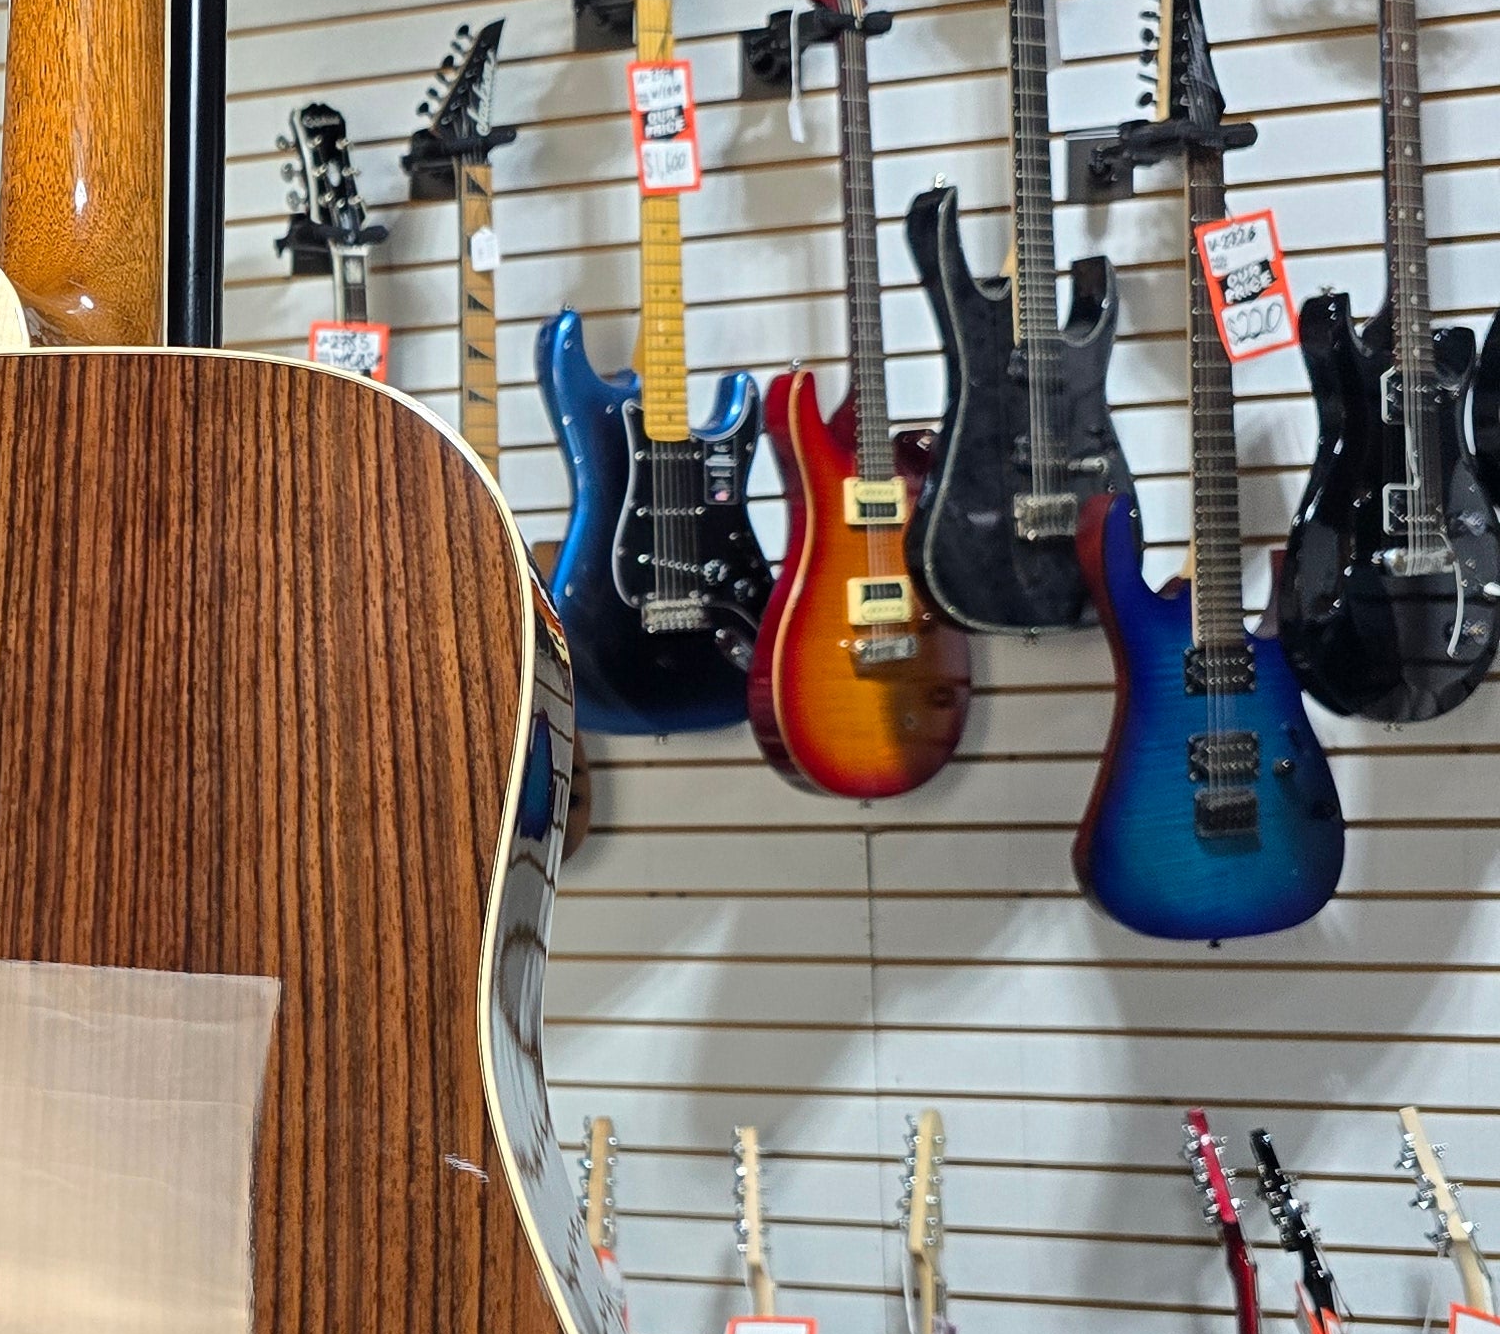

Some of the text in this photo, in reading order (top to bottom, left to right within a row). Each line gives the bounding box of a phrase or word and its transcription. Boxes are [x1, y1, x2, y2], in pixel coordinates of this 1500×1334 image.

[644, 117, 687, 140] PRICE
[646, 108, 679, 126] OUR
[1224, 270, 1274, 305] PRICE
[1226, 264, 1262, 289] OUR
